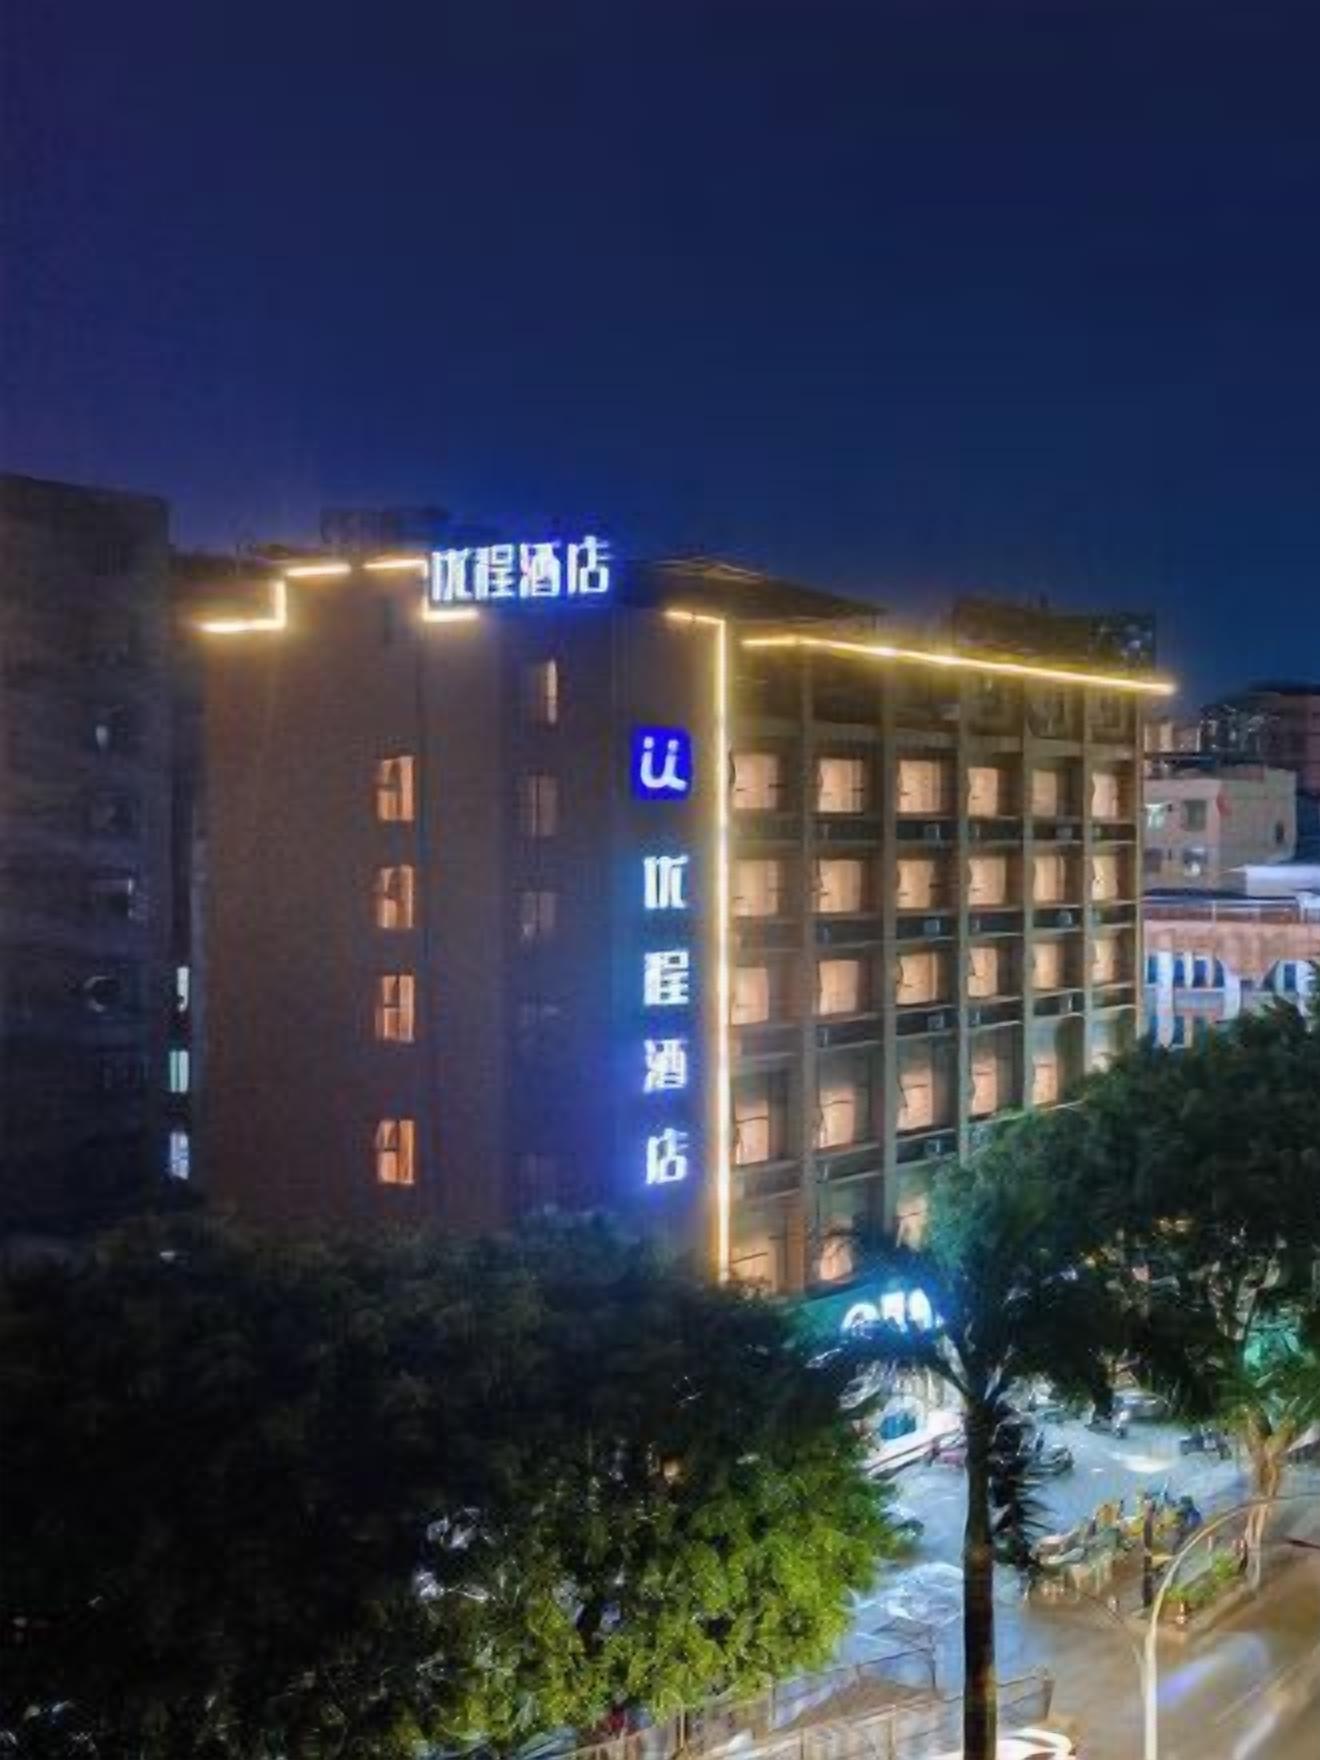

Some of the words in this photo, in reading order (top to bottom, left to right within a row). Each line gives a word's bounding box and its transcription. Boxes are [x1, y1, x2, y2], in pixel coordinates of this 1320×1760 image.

[431, 535, 610, 601] 优程酒店
[643, 854, 690, 1185] 优程酒店
